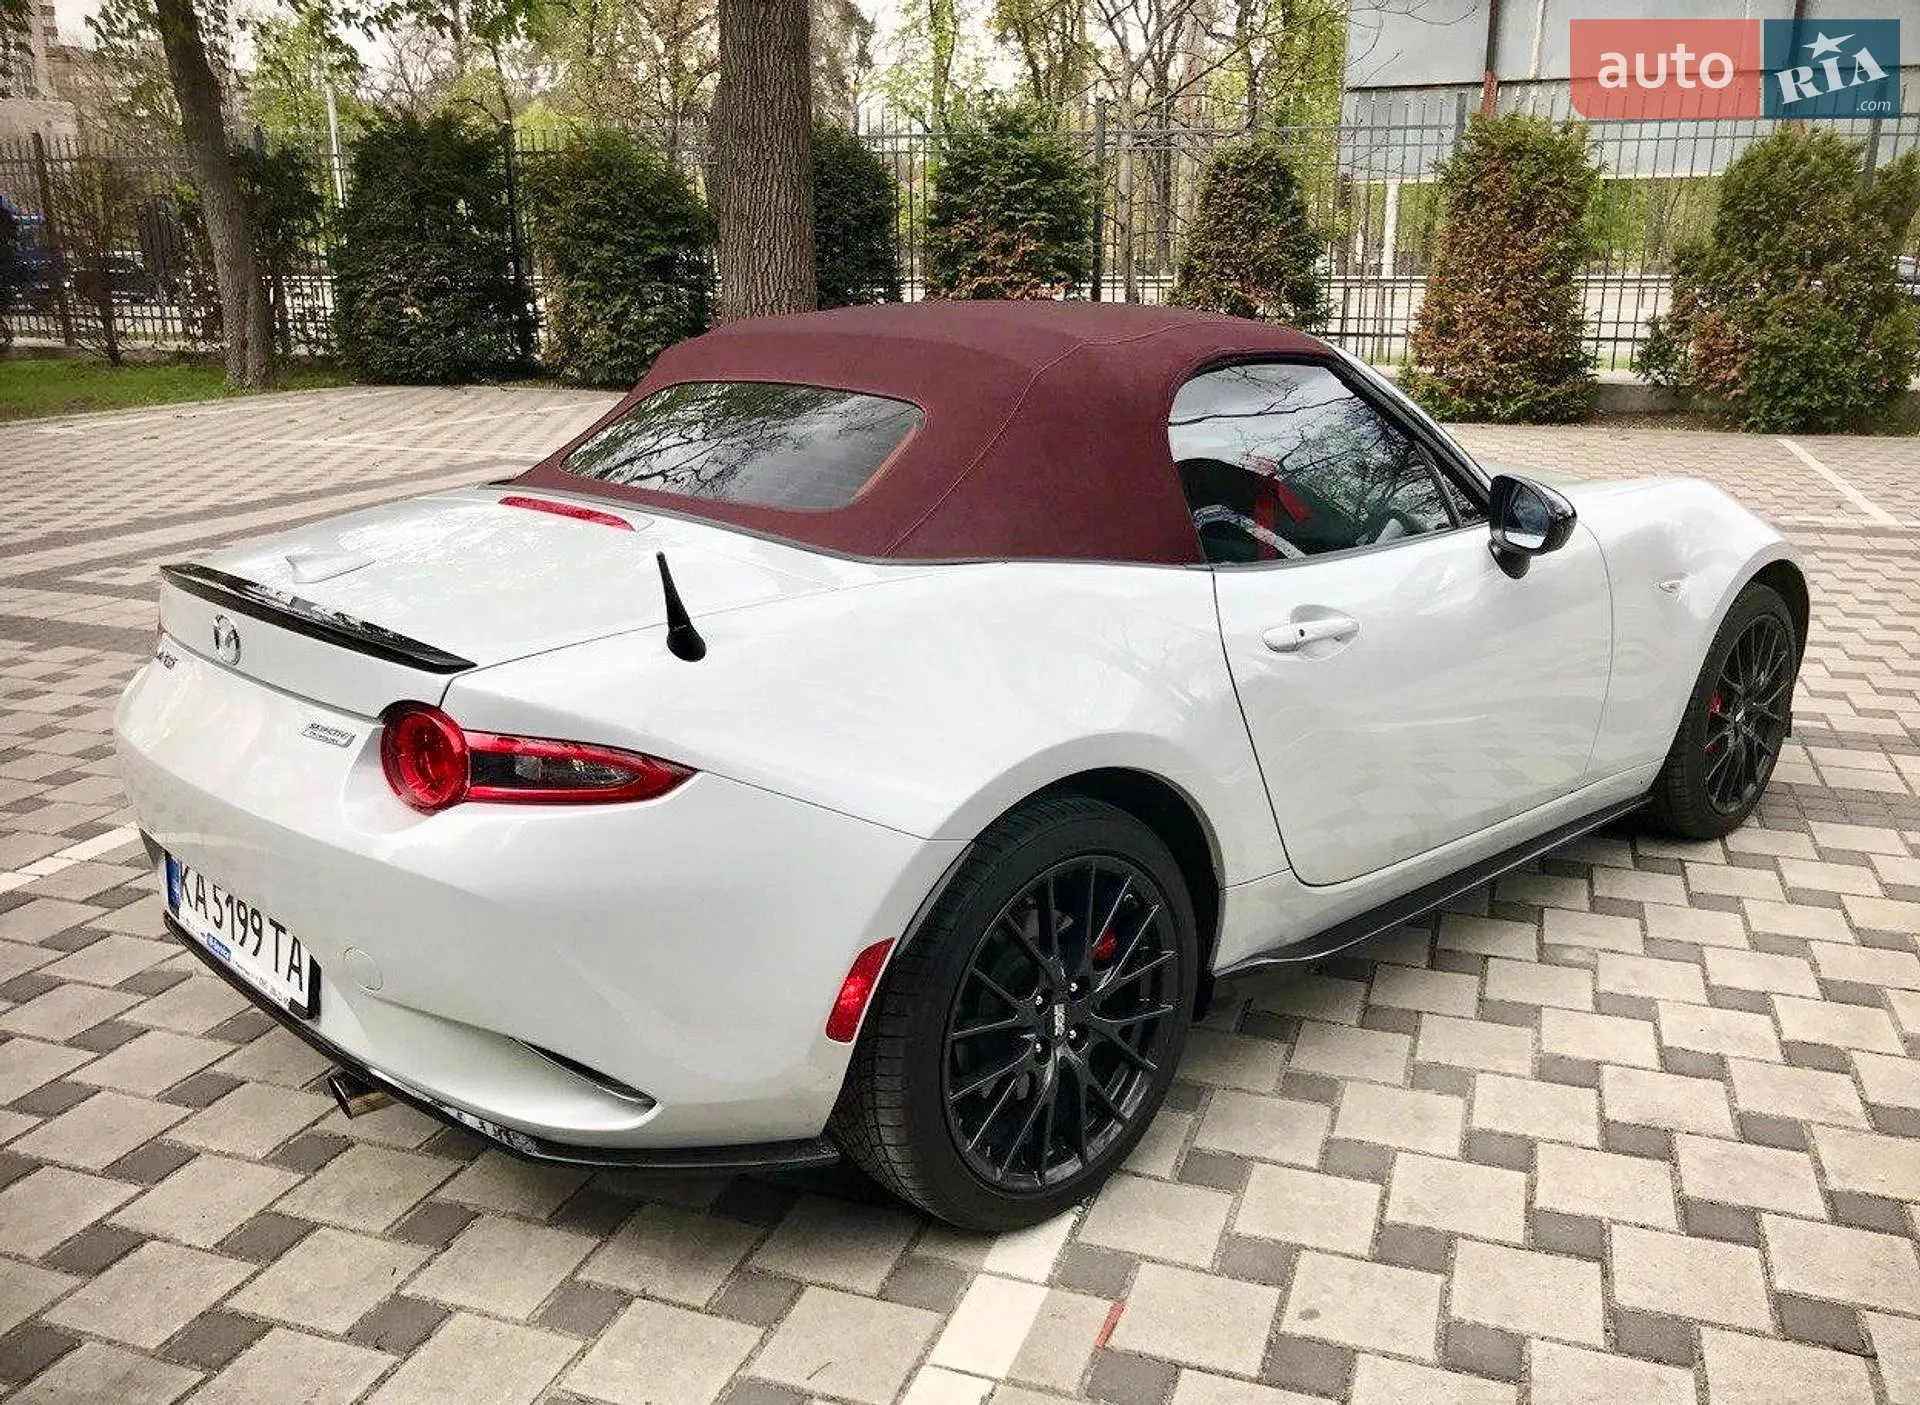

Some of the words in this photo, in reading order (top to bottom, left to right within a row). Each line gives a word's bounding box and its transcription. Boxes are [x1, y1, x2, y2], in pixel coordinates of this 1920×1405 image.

[180, 866, 208, 920] KA
[212, 884, 263, 957] 5199
[269, 917, 303, 992] TA
